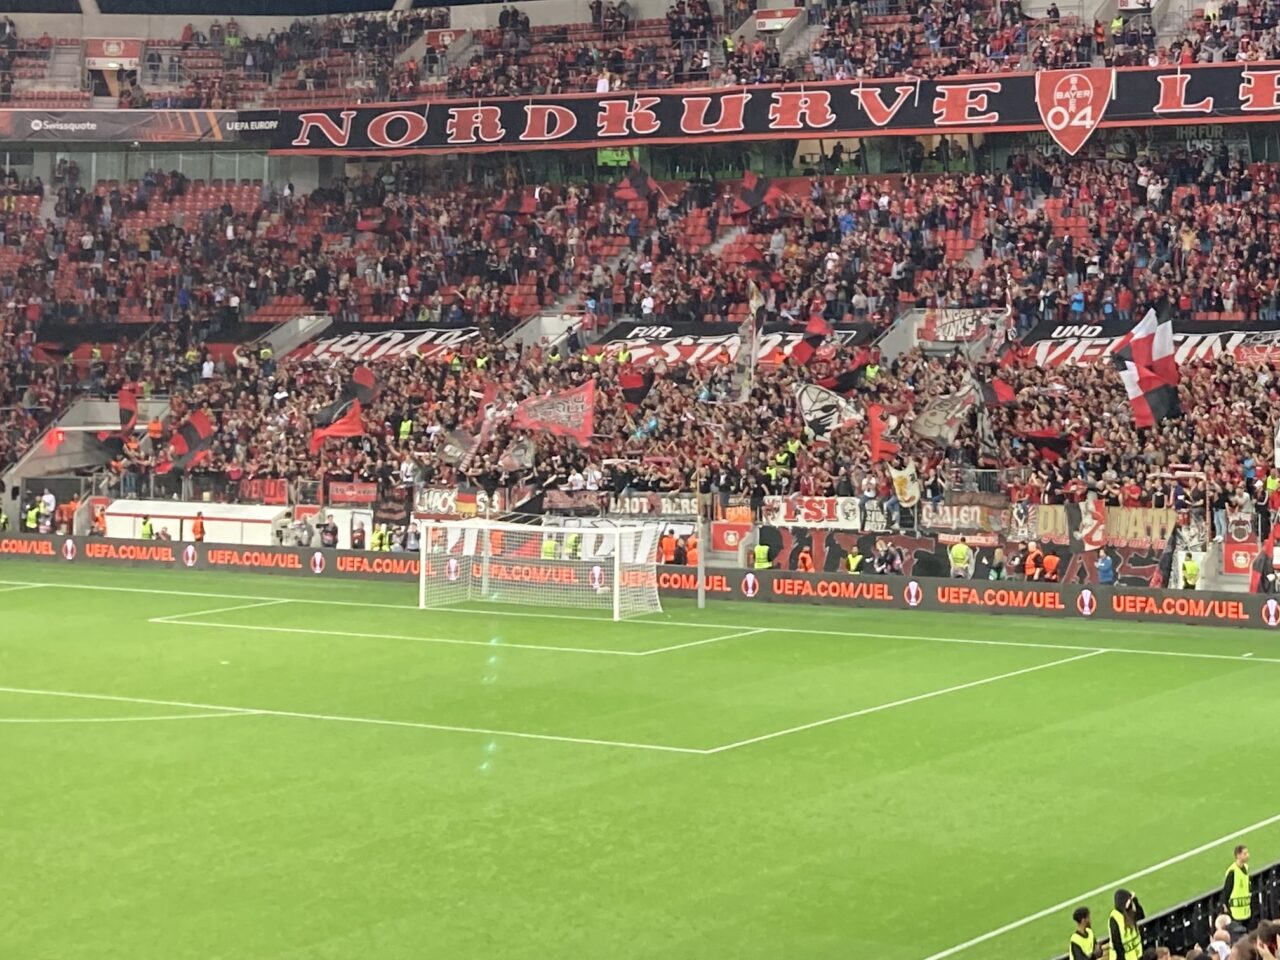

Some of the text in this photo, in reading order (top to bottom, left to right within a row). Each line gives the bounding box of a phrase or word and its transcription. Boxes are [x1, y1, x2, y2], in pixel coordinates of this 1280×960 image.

[291, 81, 1002, 148] NORDKURVE
[1046, 105, 1094, 131] 04
[43, 120, 97, 131] Swissquote
[226, 121, 249, 131] UEFA
[1050, 325, 1103, 338] UND
[85, 542, 176, 561] UEFA.COM/UEL
[207, 549, 303, 569] UEFA.COM/UEL
[772, 578, 894, 600] UEFA.COM/UEL
[937, 586, 1065, 609] UEFA.COM/UEL
[1112, 595, 1250, 620] UEFA.COM/UEL
